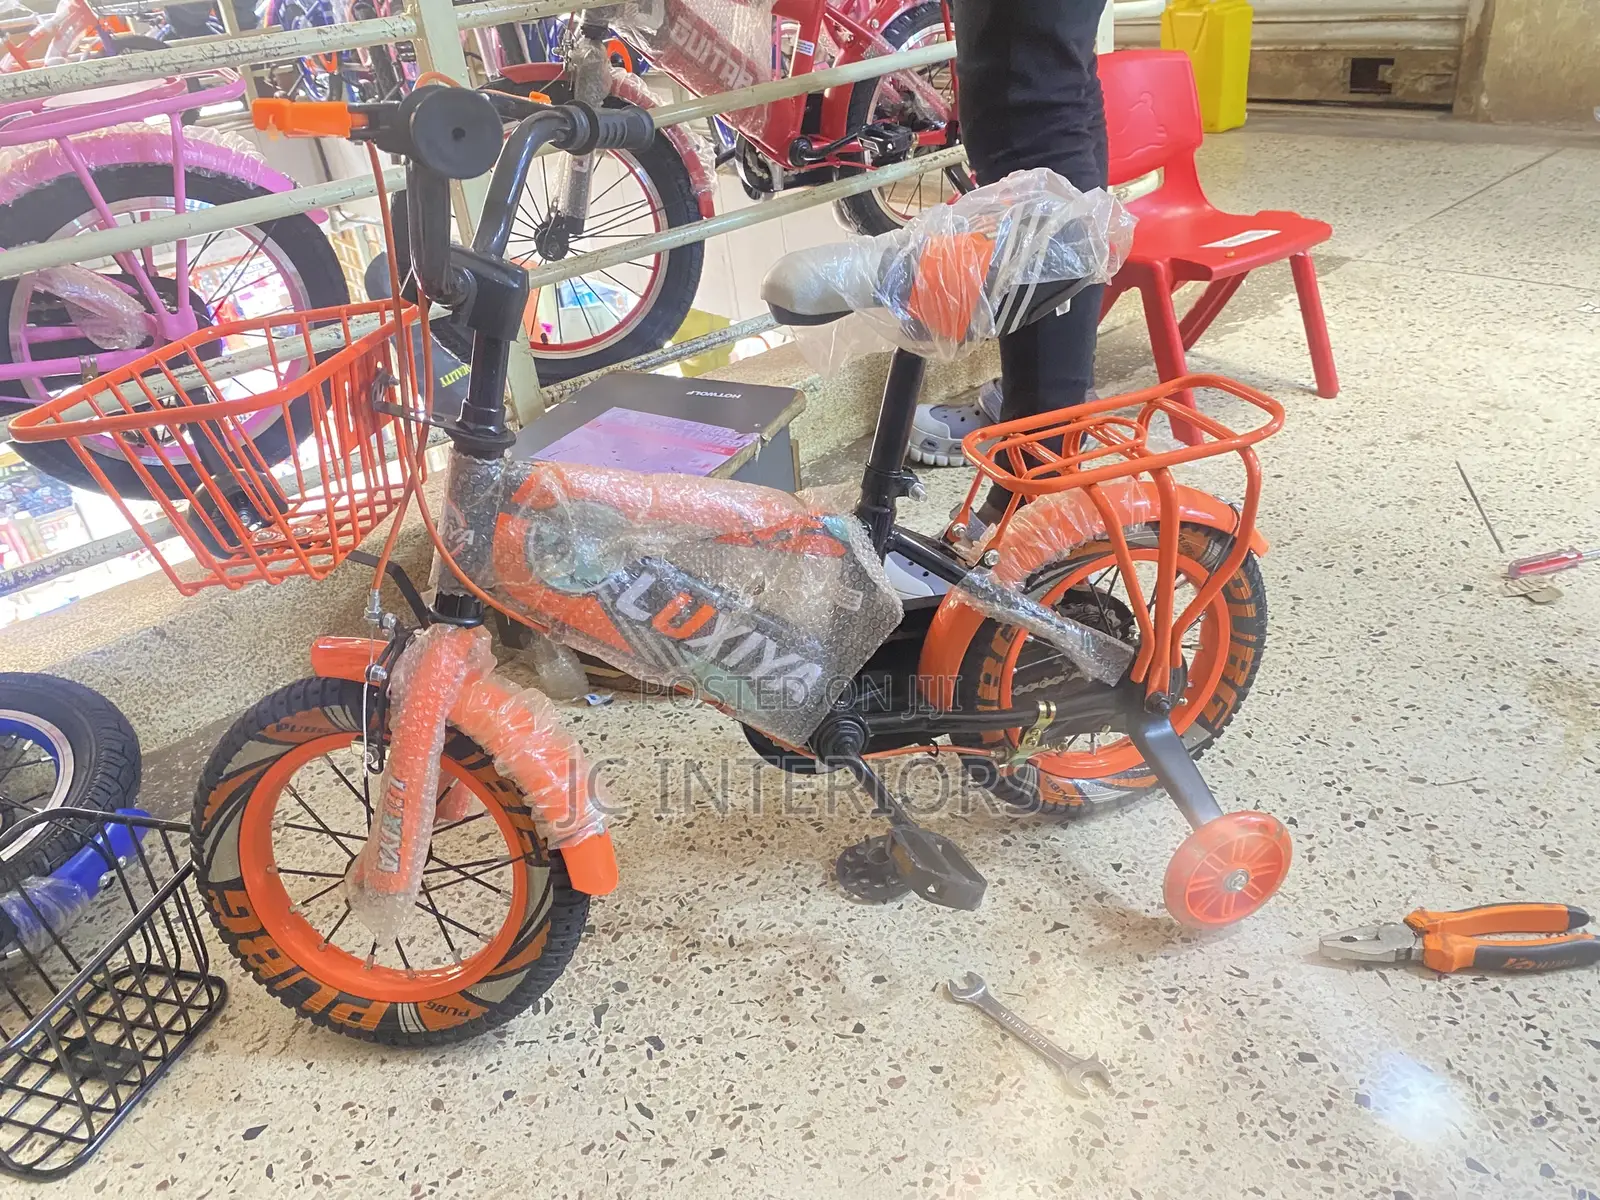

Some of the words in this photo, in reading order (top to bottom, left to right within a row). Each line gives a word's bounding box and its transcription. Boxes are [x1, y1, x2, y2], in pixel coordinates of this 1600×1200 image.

[670, 16, 754, 90] GUITAR
[616, 571, 823, 703] LUXIYA
[208, 889, 390, 1032] PUBG
[424, 1000, 471, 1017] PUBG
